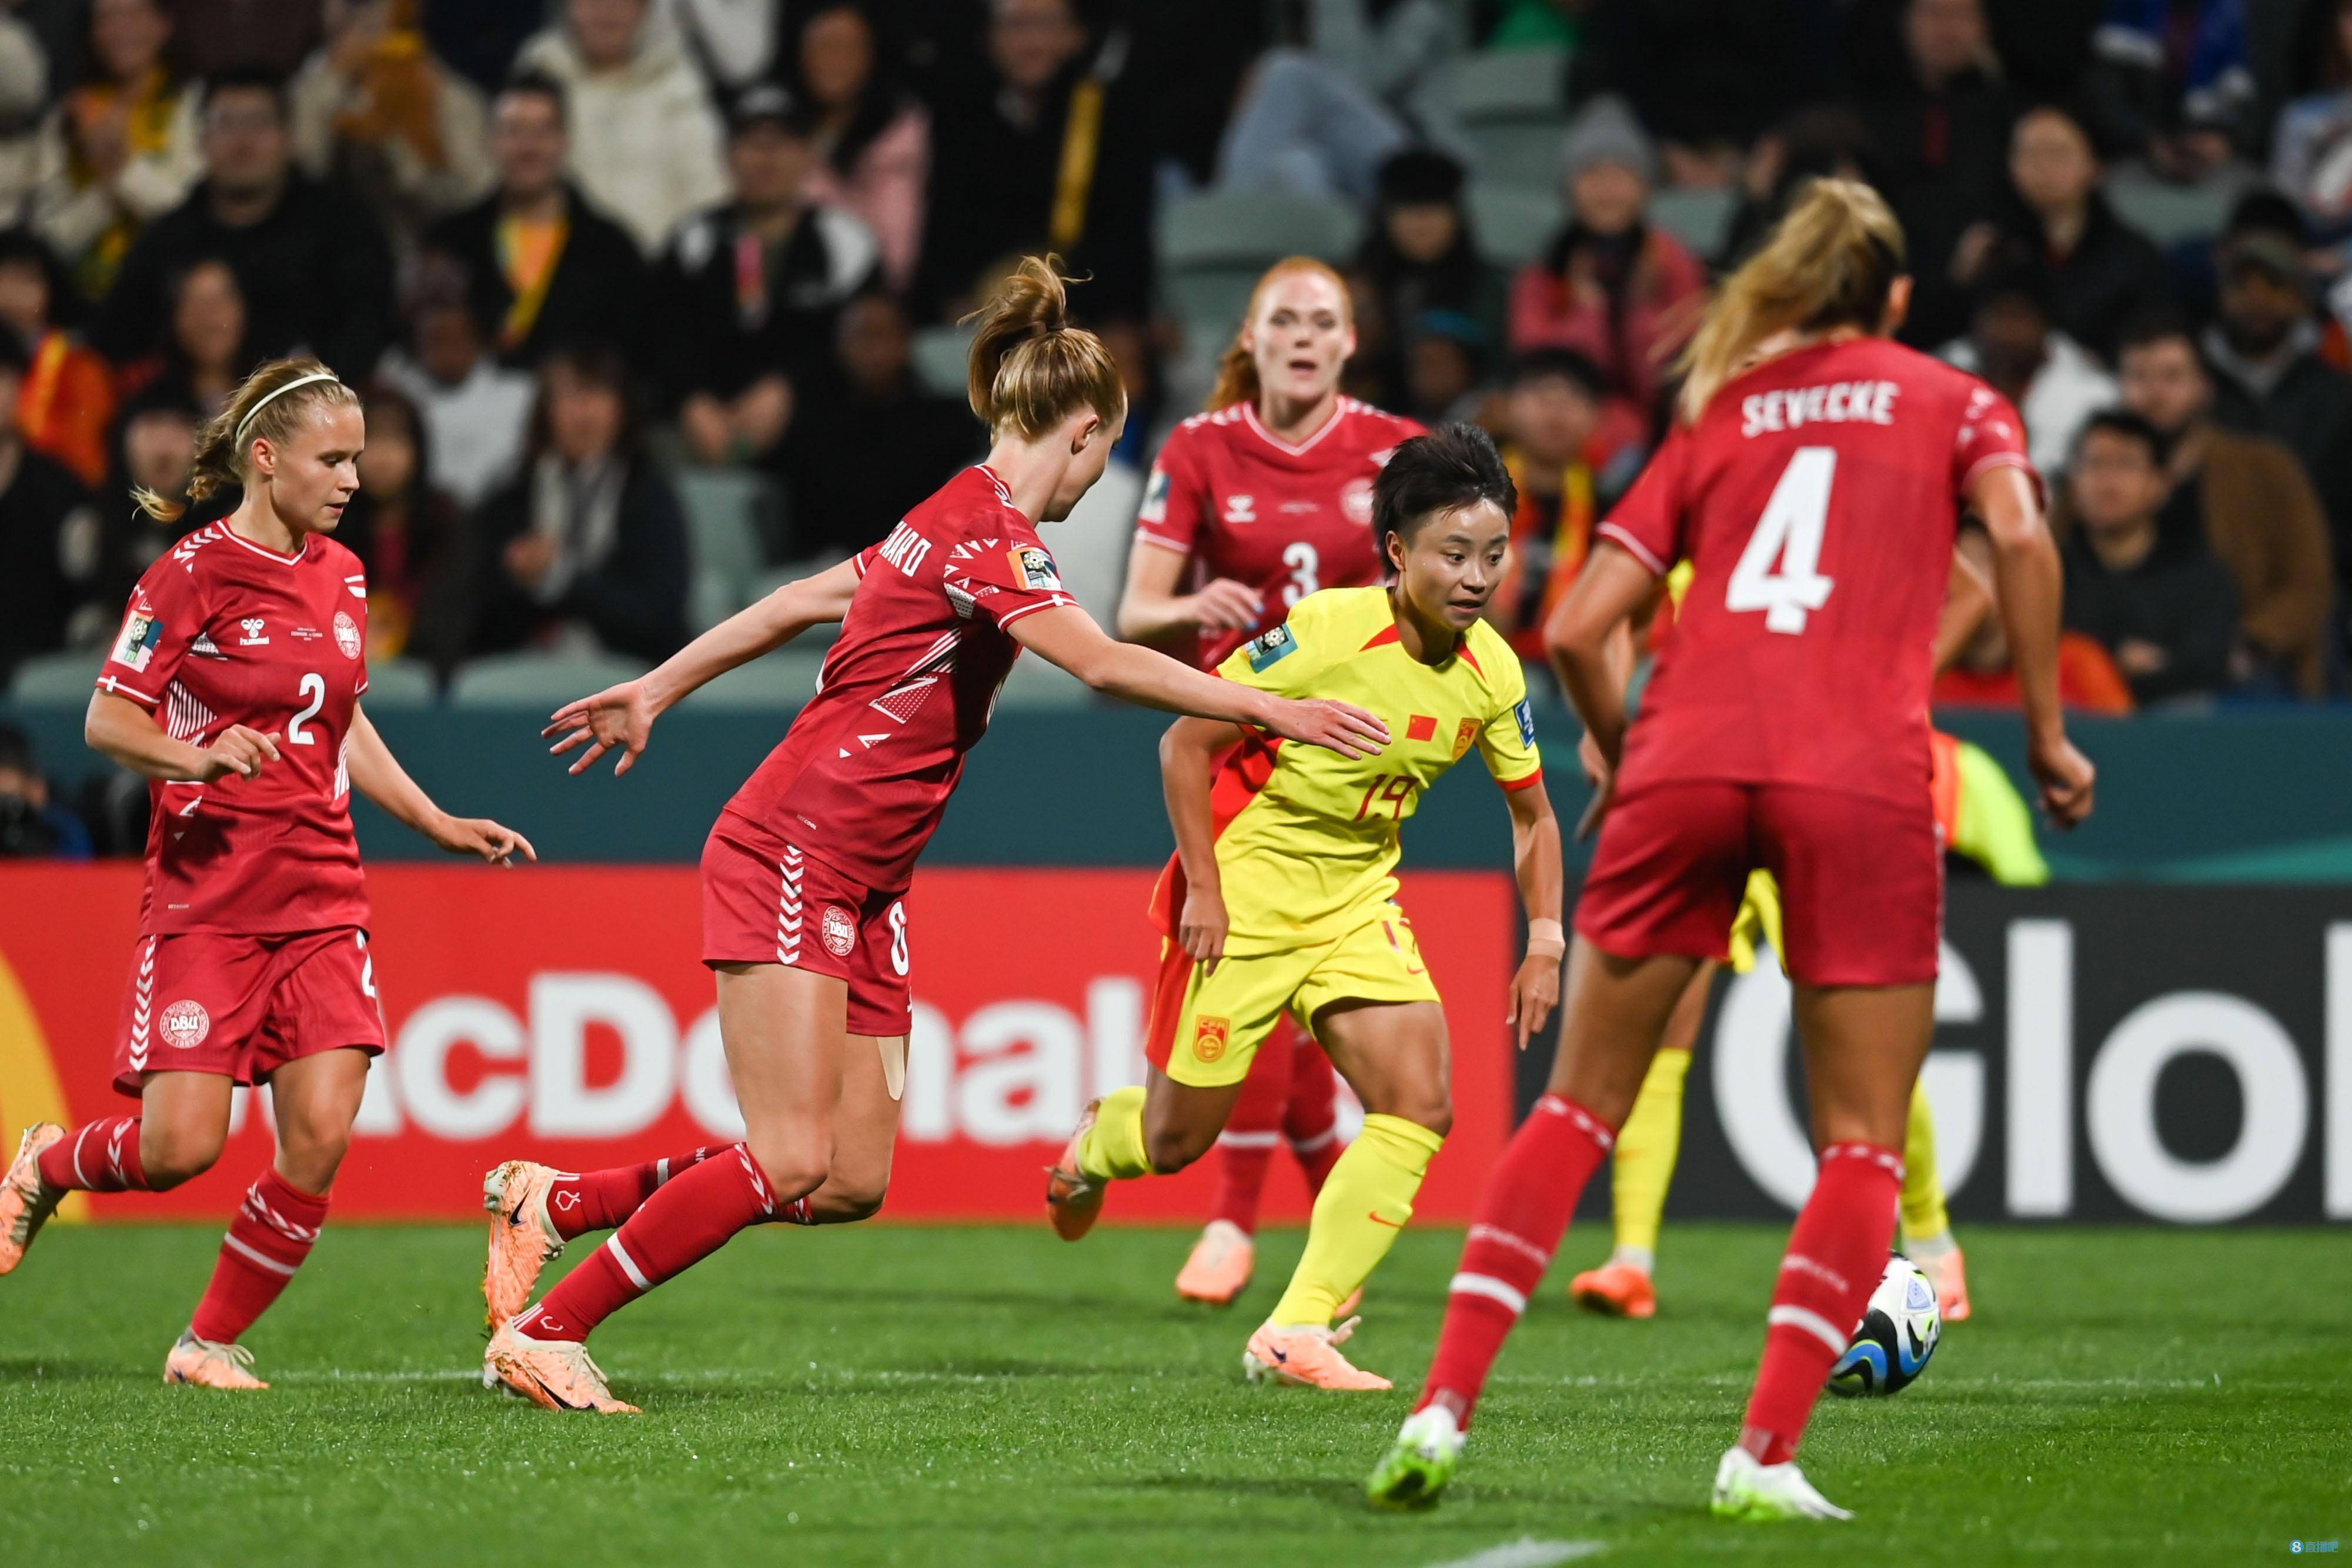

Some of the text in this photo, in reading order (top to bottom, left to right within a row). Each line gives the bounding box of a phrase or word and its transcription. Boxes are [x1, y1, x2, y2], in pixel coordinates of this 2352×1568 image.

[1741, 380, 1900, 438] SEVECKE
[1725, 446, 1838, 636] 4
[1282, 542, 1319, 608] 3
[288, 672, 325, 745] 2
[1354, 773, 1420, 821] 19
[170, 1015, 198, 1031] DBU
[1710, 918, 2352, 1225] Glo
